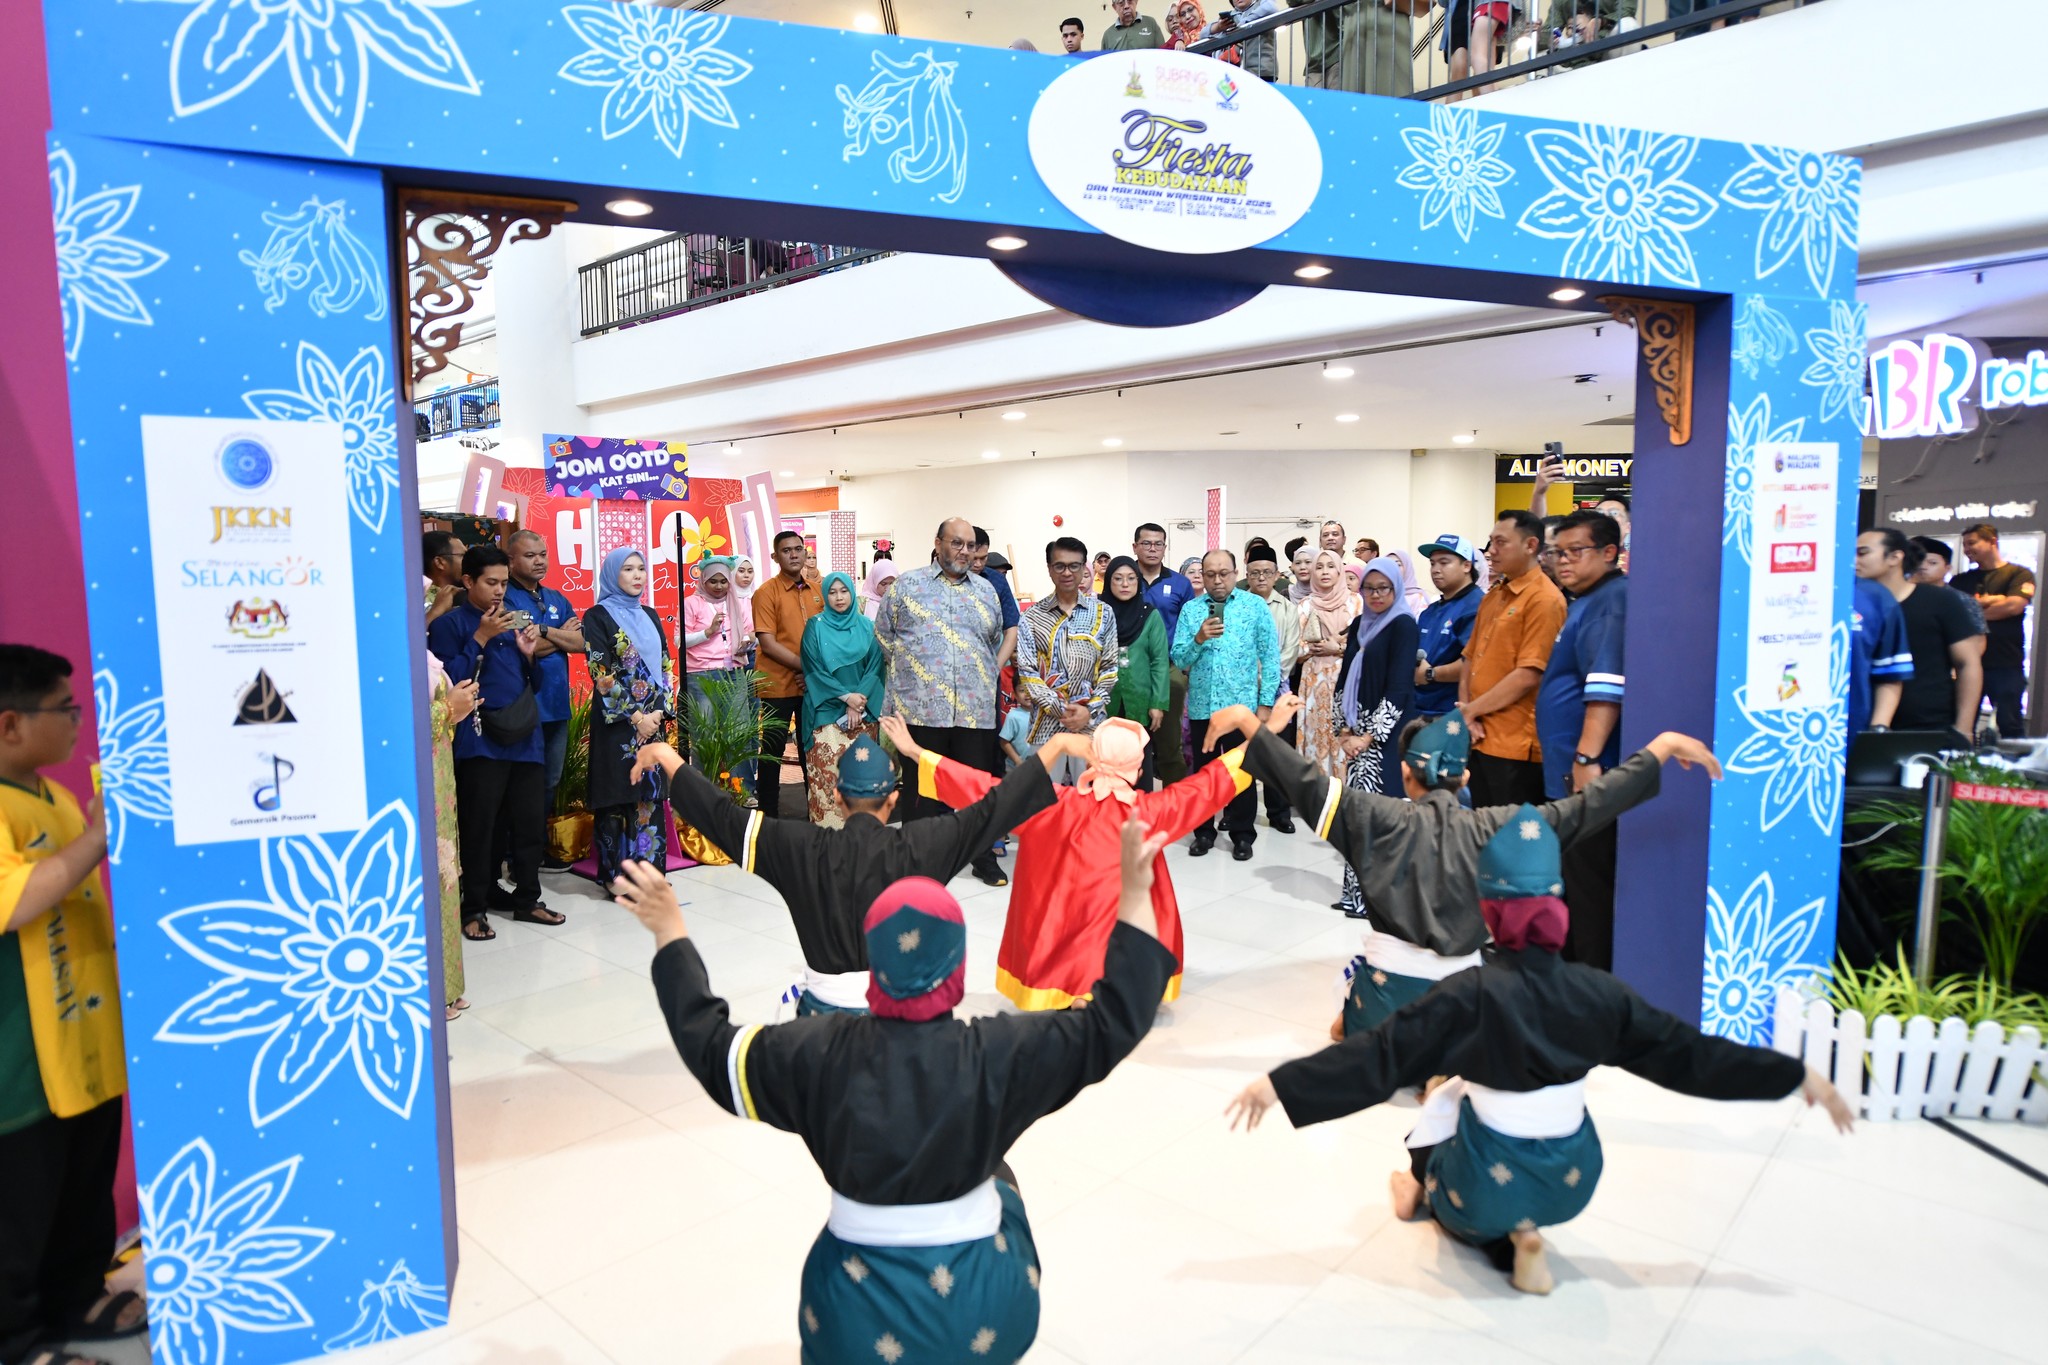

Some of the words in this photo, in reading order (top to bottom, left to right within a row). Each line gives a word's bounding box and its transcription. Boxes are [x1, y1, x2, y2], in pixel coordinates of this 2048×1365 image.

[1112, 109, 1253, 179] Fiesta
[1115, 166, 1248, 196] KEBUDAYAAN
[1086, 184, 1108, 192] DAN
[1112, 186, 1163, 198] MAKANAN
[1166, 192, 1213, 202] WARISAN
[1216, 196, 1244, 206] MBSJ
[1245, 199, 1272, 209] 2025
[555, 457, 605, 479] JOM
[608, 450, 671, 472] OOTD
[1563, 459, 1634, 477] MONEY
[599, 475, 624, 488] KAT
[626, 472, 660, 485] SINI...
[209, 505, 292, 545] JKKN
[181, 557, 324, 588] SELANGOR
